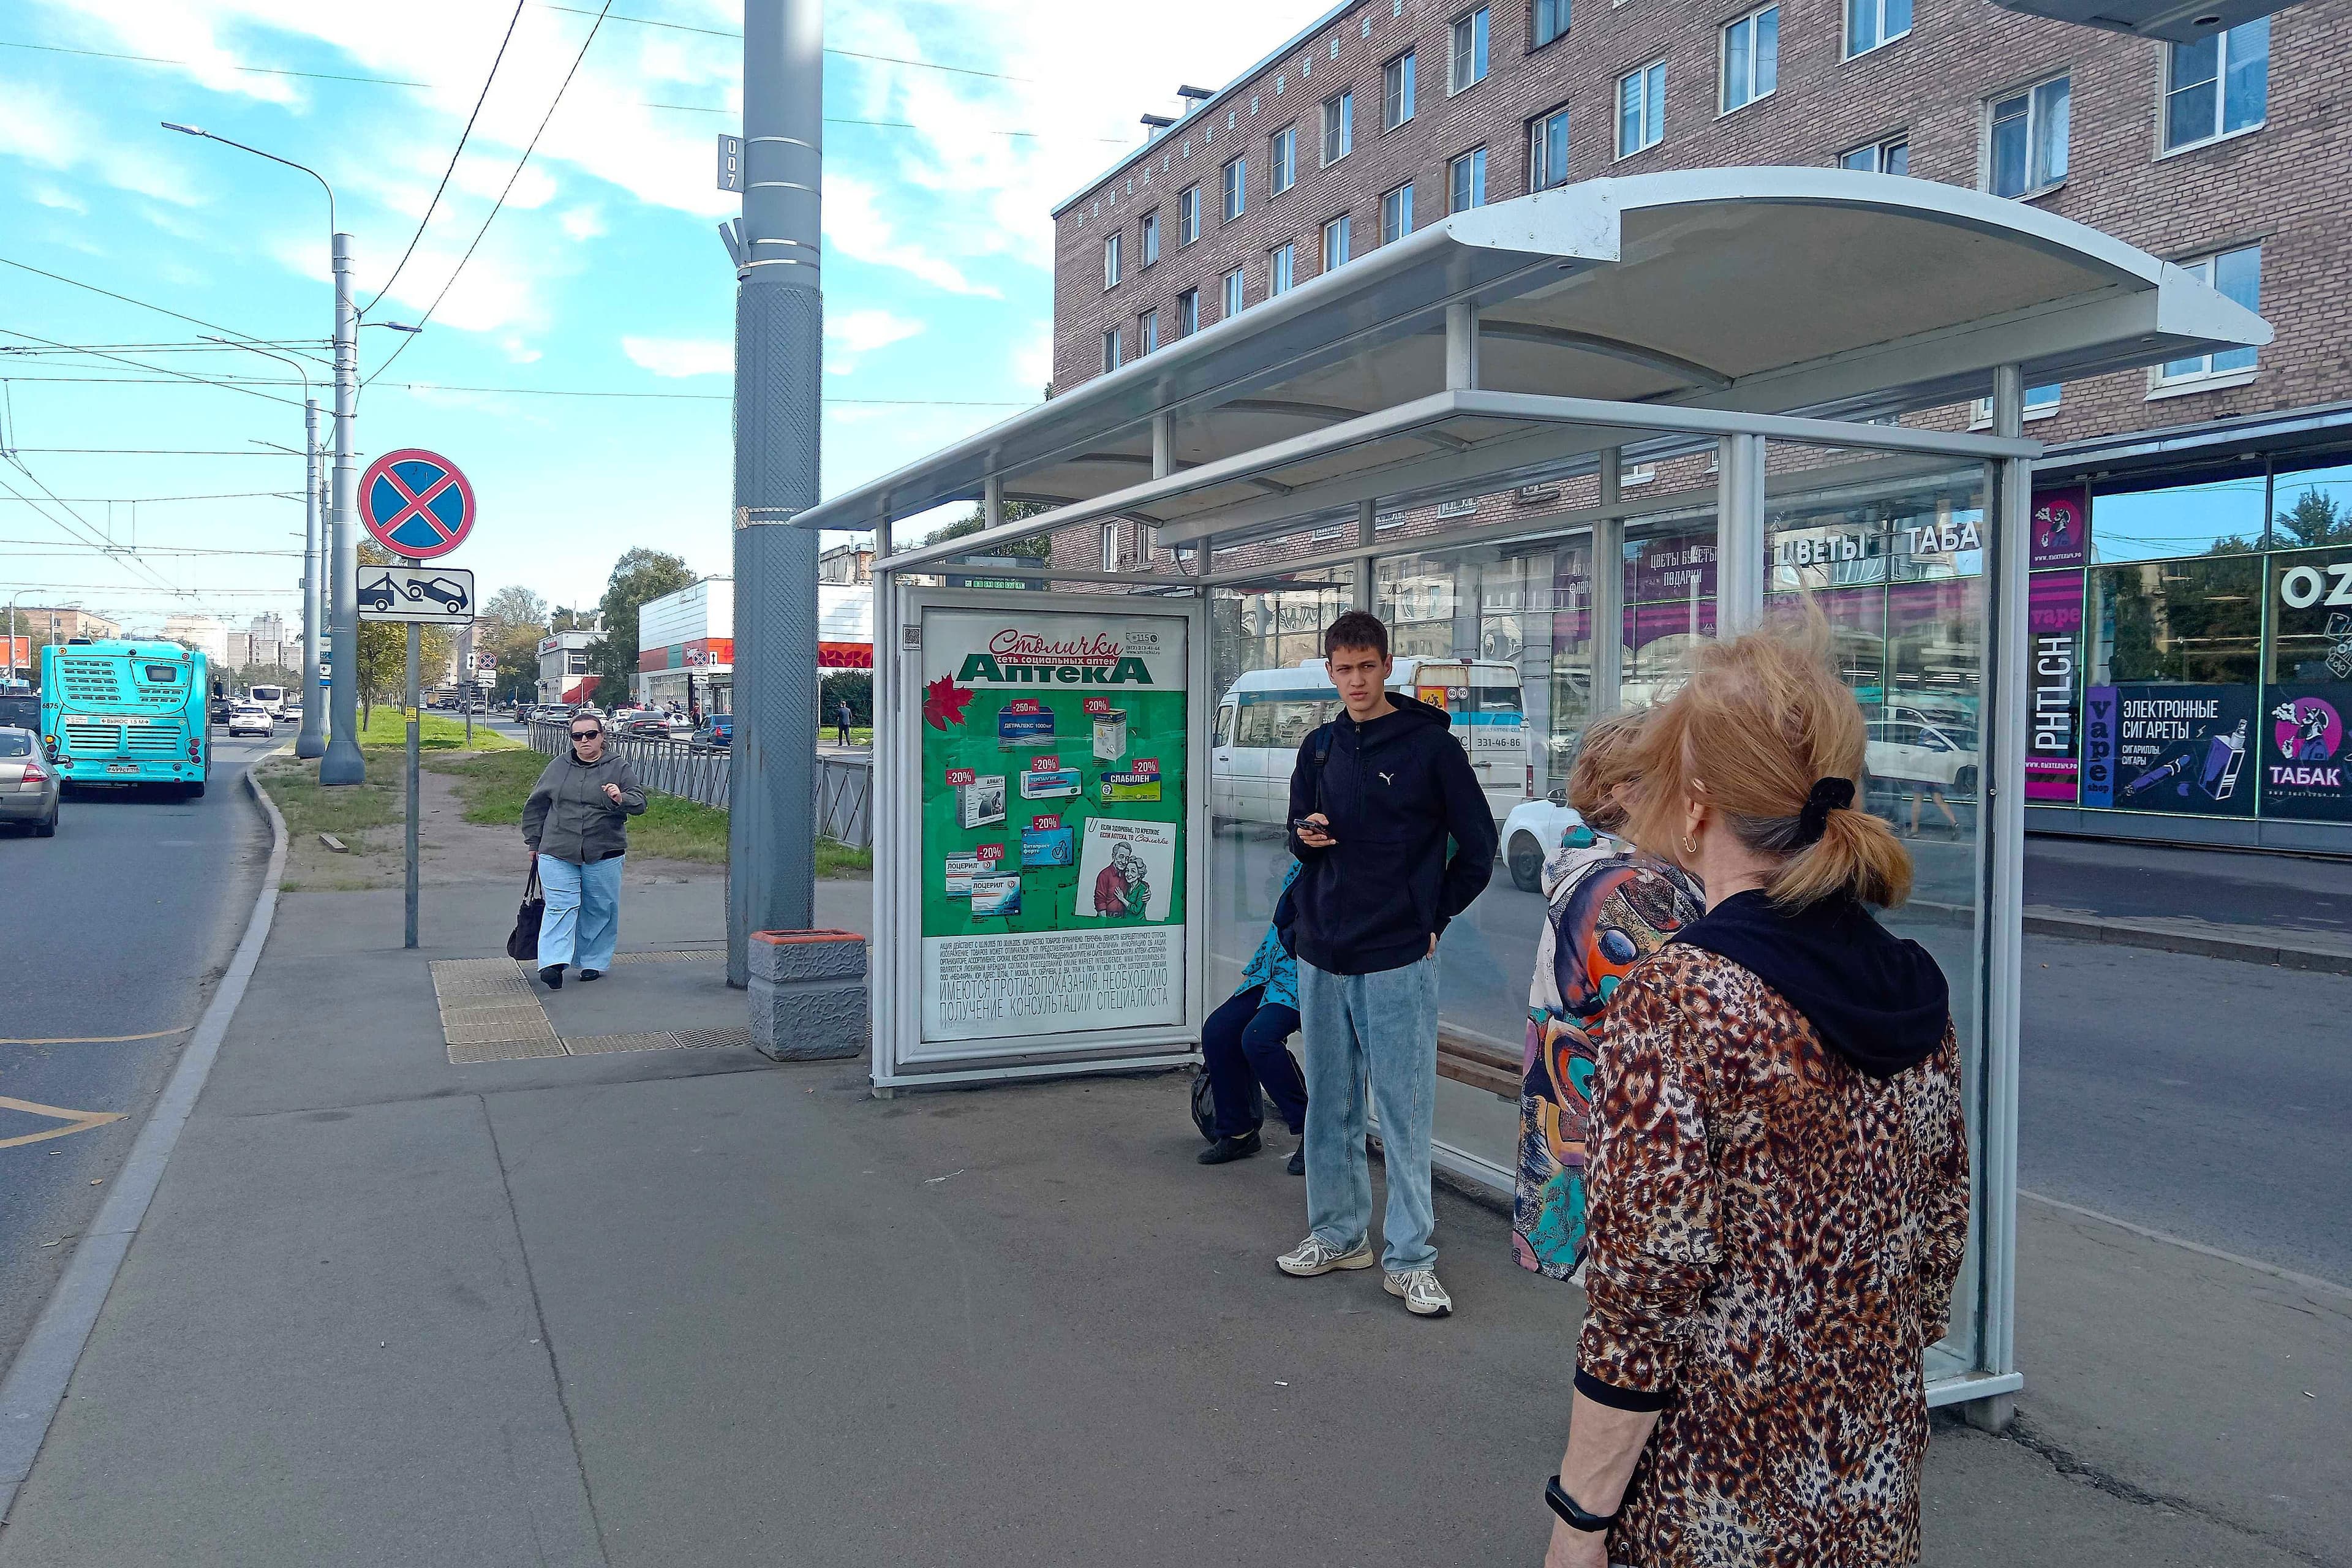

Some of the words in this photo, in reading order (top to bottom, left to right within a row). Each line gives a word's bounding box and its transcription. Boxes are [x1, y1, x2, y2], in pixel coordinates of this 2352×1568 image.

[727, 139, 737, 189] 007
[1779, 533, 1866, 566] ЦВЕТЫ
[1905, 521, 1981, 554] ТАБА
[1651, 552, 1678, 570] ЦВЕТЫ
[1664, 569, 1702, 588] ПОДАРКИ
[2032, 608, 2081, 627] vape
[989, 630, 1124, 655] Столички
[1021, 657, 1084, 665] социальных
[2035, 637, 2072, 750] PHTLCH
[1085, 700, 1107, 711] -20%
[2123, 700, 2218, 718] ЭЛЕКТРОННЫЕ
[2123, 721, 2189, 739] СИГАРЕТЫ
[1034, 758, 1056, 770] -20%
[1134, 761, 1156, 772] -20%
[2122, 756, 2146, 765] СИГАРЫ
[948, 771, 971, 783] -20%
[1110, 774, 1150, 783] СЛАБИЛЕН
[2269, 766, 2340, 785] ТАБАК
[1035, 817, 1057, 829] -20%
[979, 847, 1001, 858] -20%
[940, 979, 990, 1001] ИМЕЮТСЯ
[1103, 968, 1168, 992] НЕОБХОДИМО
[940, 998, 1004, 1022] ПОЛУЧЕНИЕ
[1010, 993, 1091, 1017] КОНСУЛЬТАЦИИ
[1096, 988, 1169, 1011] СПЕЦИАЛИСТА
